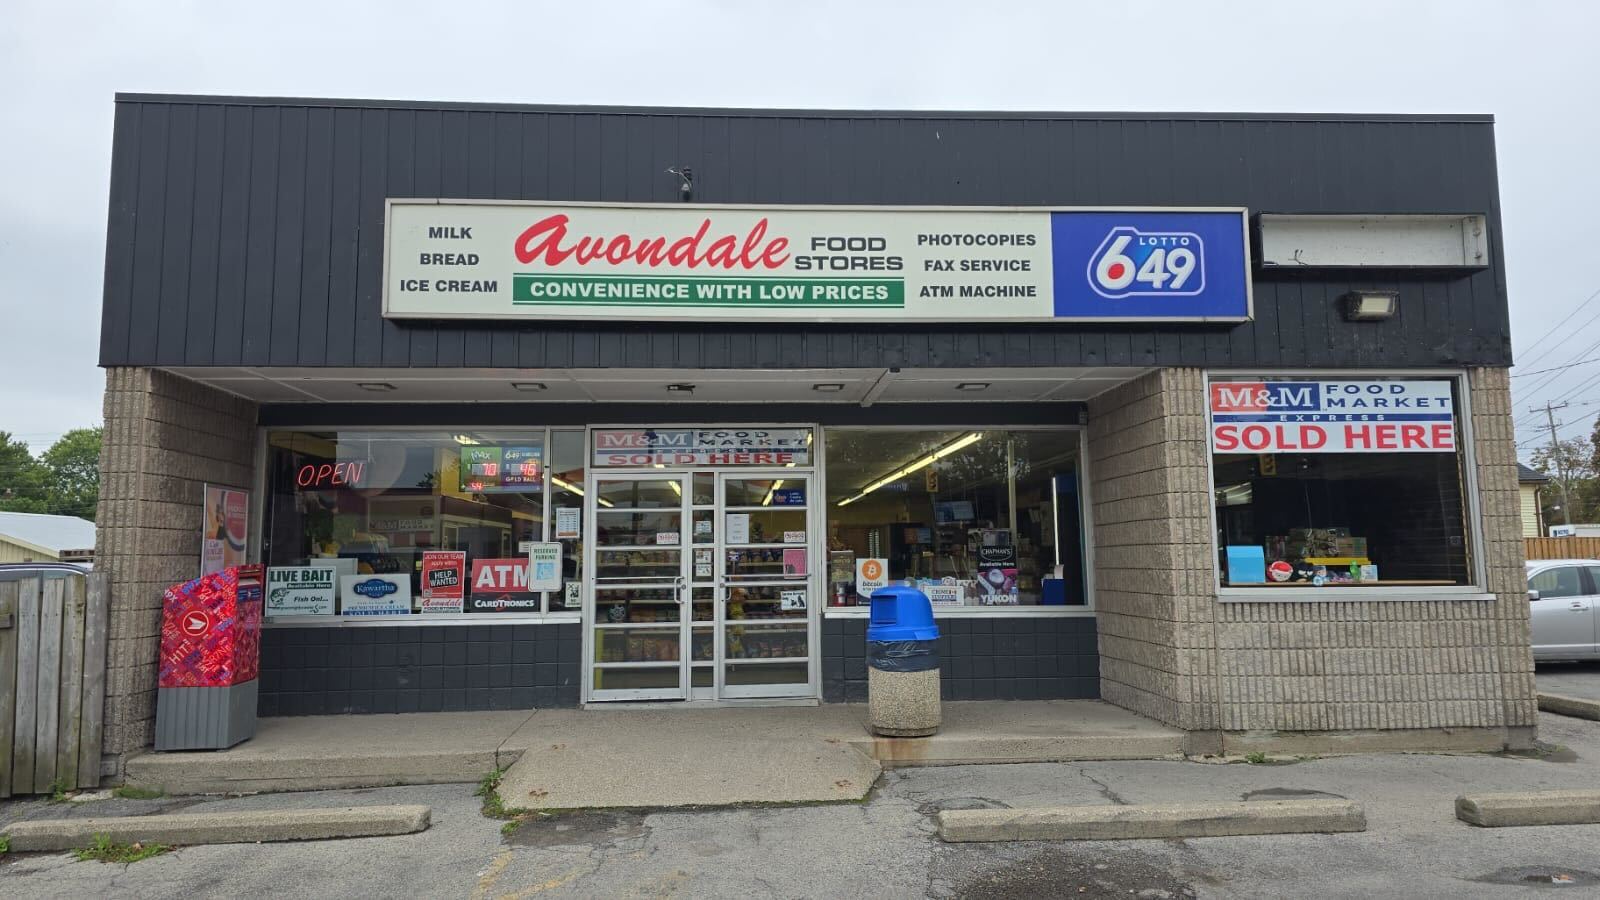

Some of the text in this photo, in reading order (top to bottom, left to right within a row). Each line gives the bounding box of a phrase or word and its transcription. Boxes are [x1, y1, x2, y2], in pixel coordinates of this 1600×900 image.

[429, 226, 472, 240] MILK
[917, 233, 1037, 247] PHOTOCOPIES
[514, 214, 791, 270] Avondale
[810, 236, 887, 252] FOOD
[1139, 236, 1190, 246] LOTTO
[420, 252, 480, 266] BREAD
[794, 255, 904, 271] STORES
[924, 259, 1032, 272] FAX SERVICE
[1096, 235, 1196, 290] 649
[400, 279, 498, 293] ICE CREAM
[530, 281, 890, 301] CONVENIENCE WITH LOW PRICES
[919, 284, 1037, 298] ATM MACHINE
[1326, 384, 1406, 395] FOOD
[1217, 387, 1313, 409] M&M
[1327, 397, 1451, 408] MARKET
[1280, 414, 1385, 422] EXPRESS
[603, 432, 688, 448] M&M
[699, 438, 807, 446] MARKET
[1214, 424, 1454, 450] SOLD HERE
[608, 453, 793, 465] SOLD HERE
[298, 462, 364, 487] OPEN
[520, 463, 537, 476] 46
[270, 570, 333, 582] LIVE BAIT
[434, 570, 452, 579] HELP
[475, 565, 529, 588] ATM
[430, 577, 458, 587] WANTED
[980, 594, 1017, 603] YUKON
